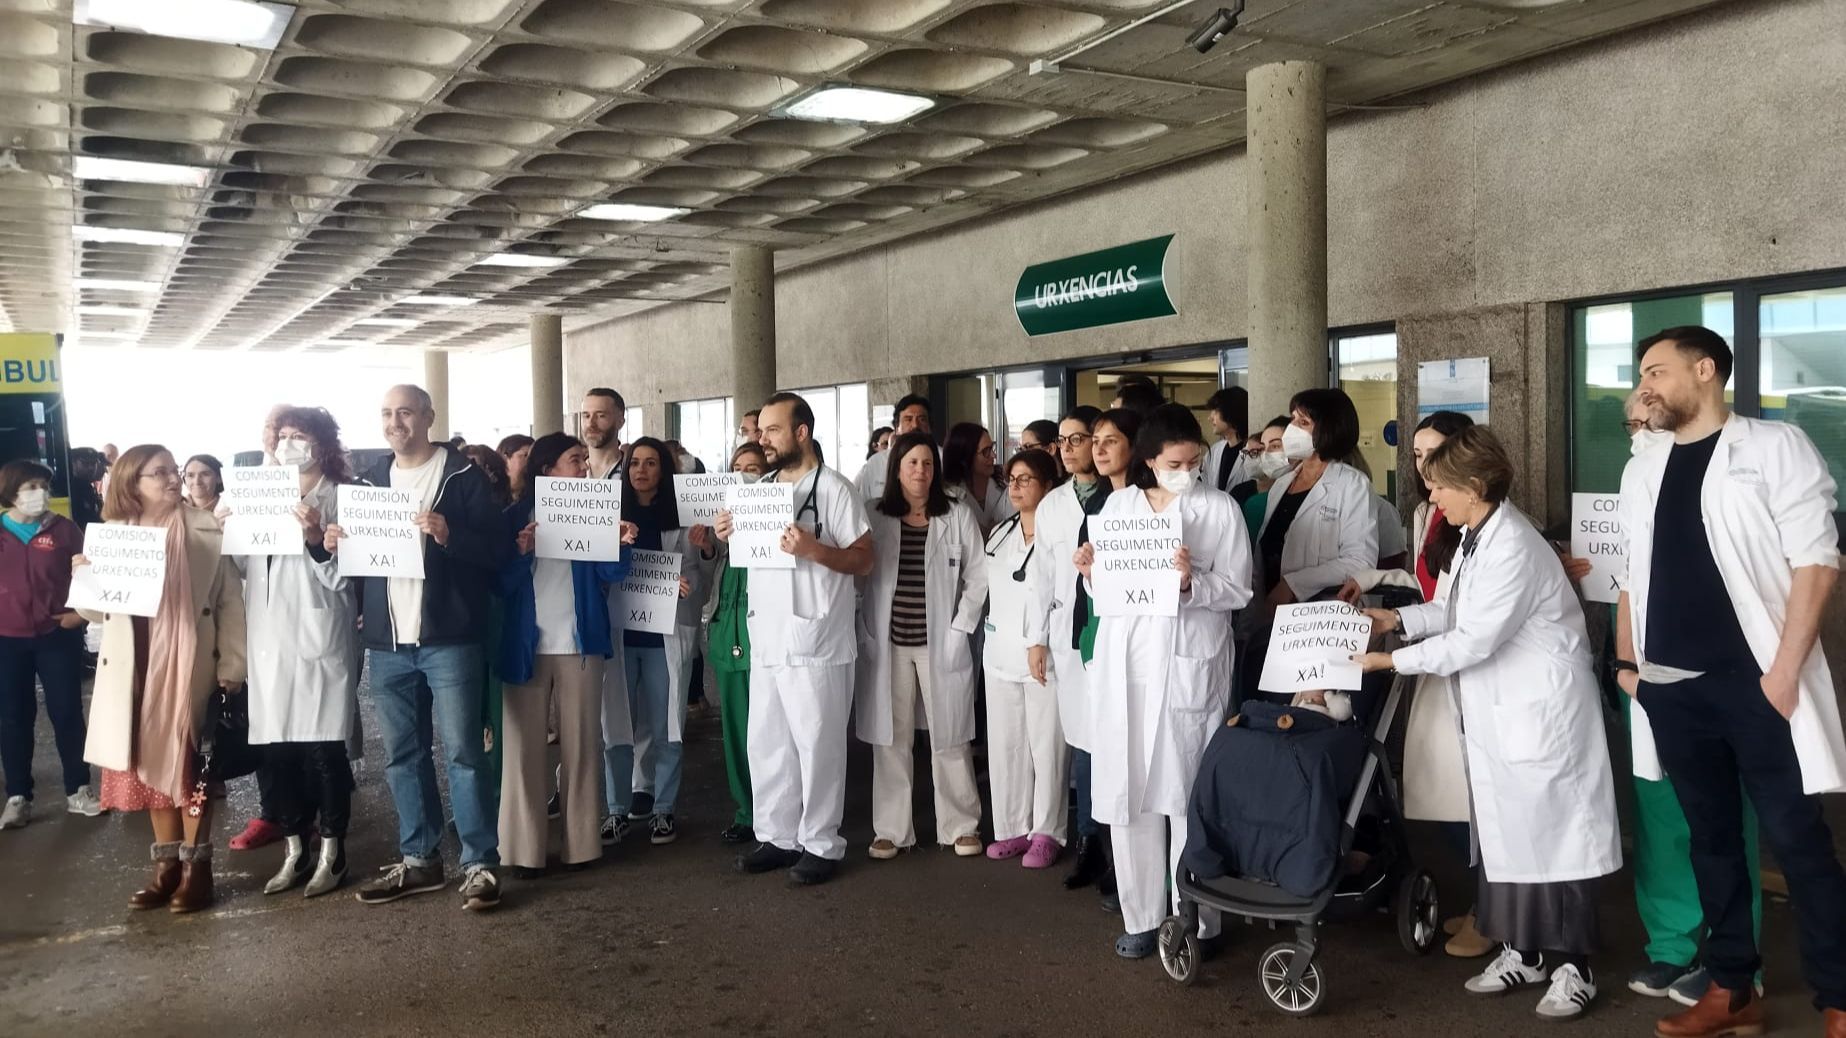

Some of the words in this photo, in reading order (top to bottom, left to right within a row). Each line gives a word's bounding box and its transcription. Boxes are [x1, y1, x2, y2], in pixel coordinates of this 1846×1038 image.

[1035, 265, 1138, 309] URXENCIAS
[0, 359, 59, 384] BUL
[235, 468, 290, 481] COMISIÓN
[685, 475, 738, 488] COMISIÓN
[230, 487, 300, 499] SEGUIMENTO
[550, 480, 612, 494] COMISIÓN
[737, 486, 786, 499] COMISIÓN
[351, 489, 410, 504] COMISIÓN
[541, 496, 620, 511] SEGUIMENTO
[680, 491, 727, 503] SEGUIME
[729, 503, 793, 516] SEGUIMENTO
[1593, 499, 1620, 512] CO
[343, 507, 418, 522] SEGUIMENTO
[548, 513, 614, 527] URXENCIAS
[1103, 517, 1171, 532] COMISIÓN
[98, 528, 157, 542] COMISIÓN
[251, 532, 277, 545] XA!
[349, 525, 413, 540] URXENCIAS
[564, 538, 590, 553] XA!
[751, 545, 772, 559] XA!
[1096, 537, 1182, 552] SEGUIMENTO
[1588, 541, 1623, 556] URX
[88, 545, 165, 561] SEGUIMENTO
[369, 552, 396, 568] XA!
[632, 552, 674, 566] OMISIÓN
[92, 564, 158, 578] URXENCIAS
[1104, 557, 1176, 572] URXENCIAS
[98, 589, 131, 604] XA!
[620, 582, 674, 597] URXENCIAS
[1125, 588, 1155, 605] XA!
[629, 608, 652, 624] XA!
[1292, 604, 1362, 618] COMISIÓN
[1278, 620, 1370, 636] SEGUIMENTO
[1282, 636, 1358, 652] URXENCIAS
[1295, 663, 1325, 683] XA!
